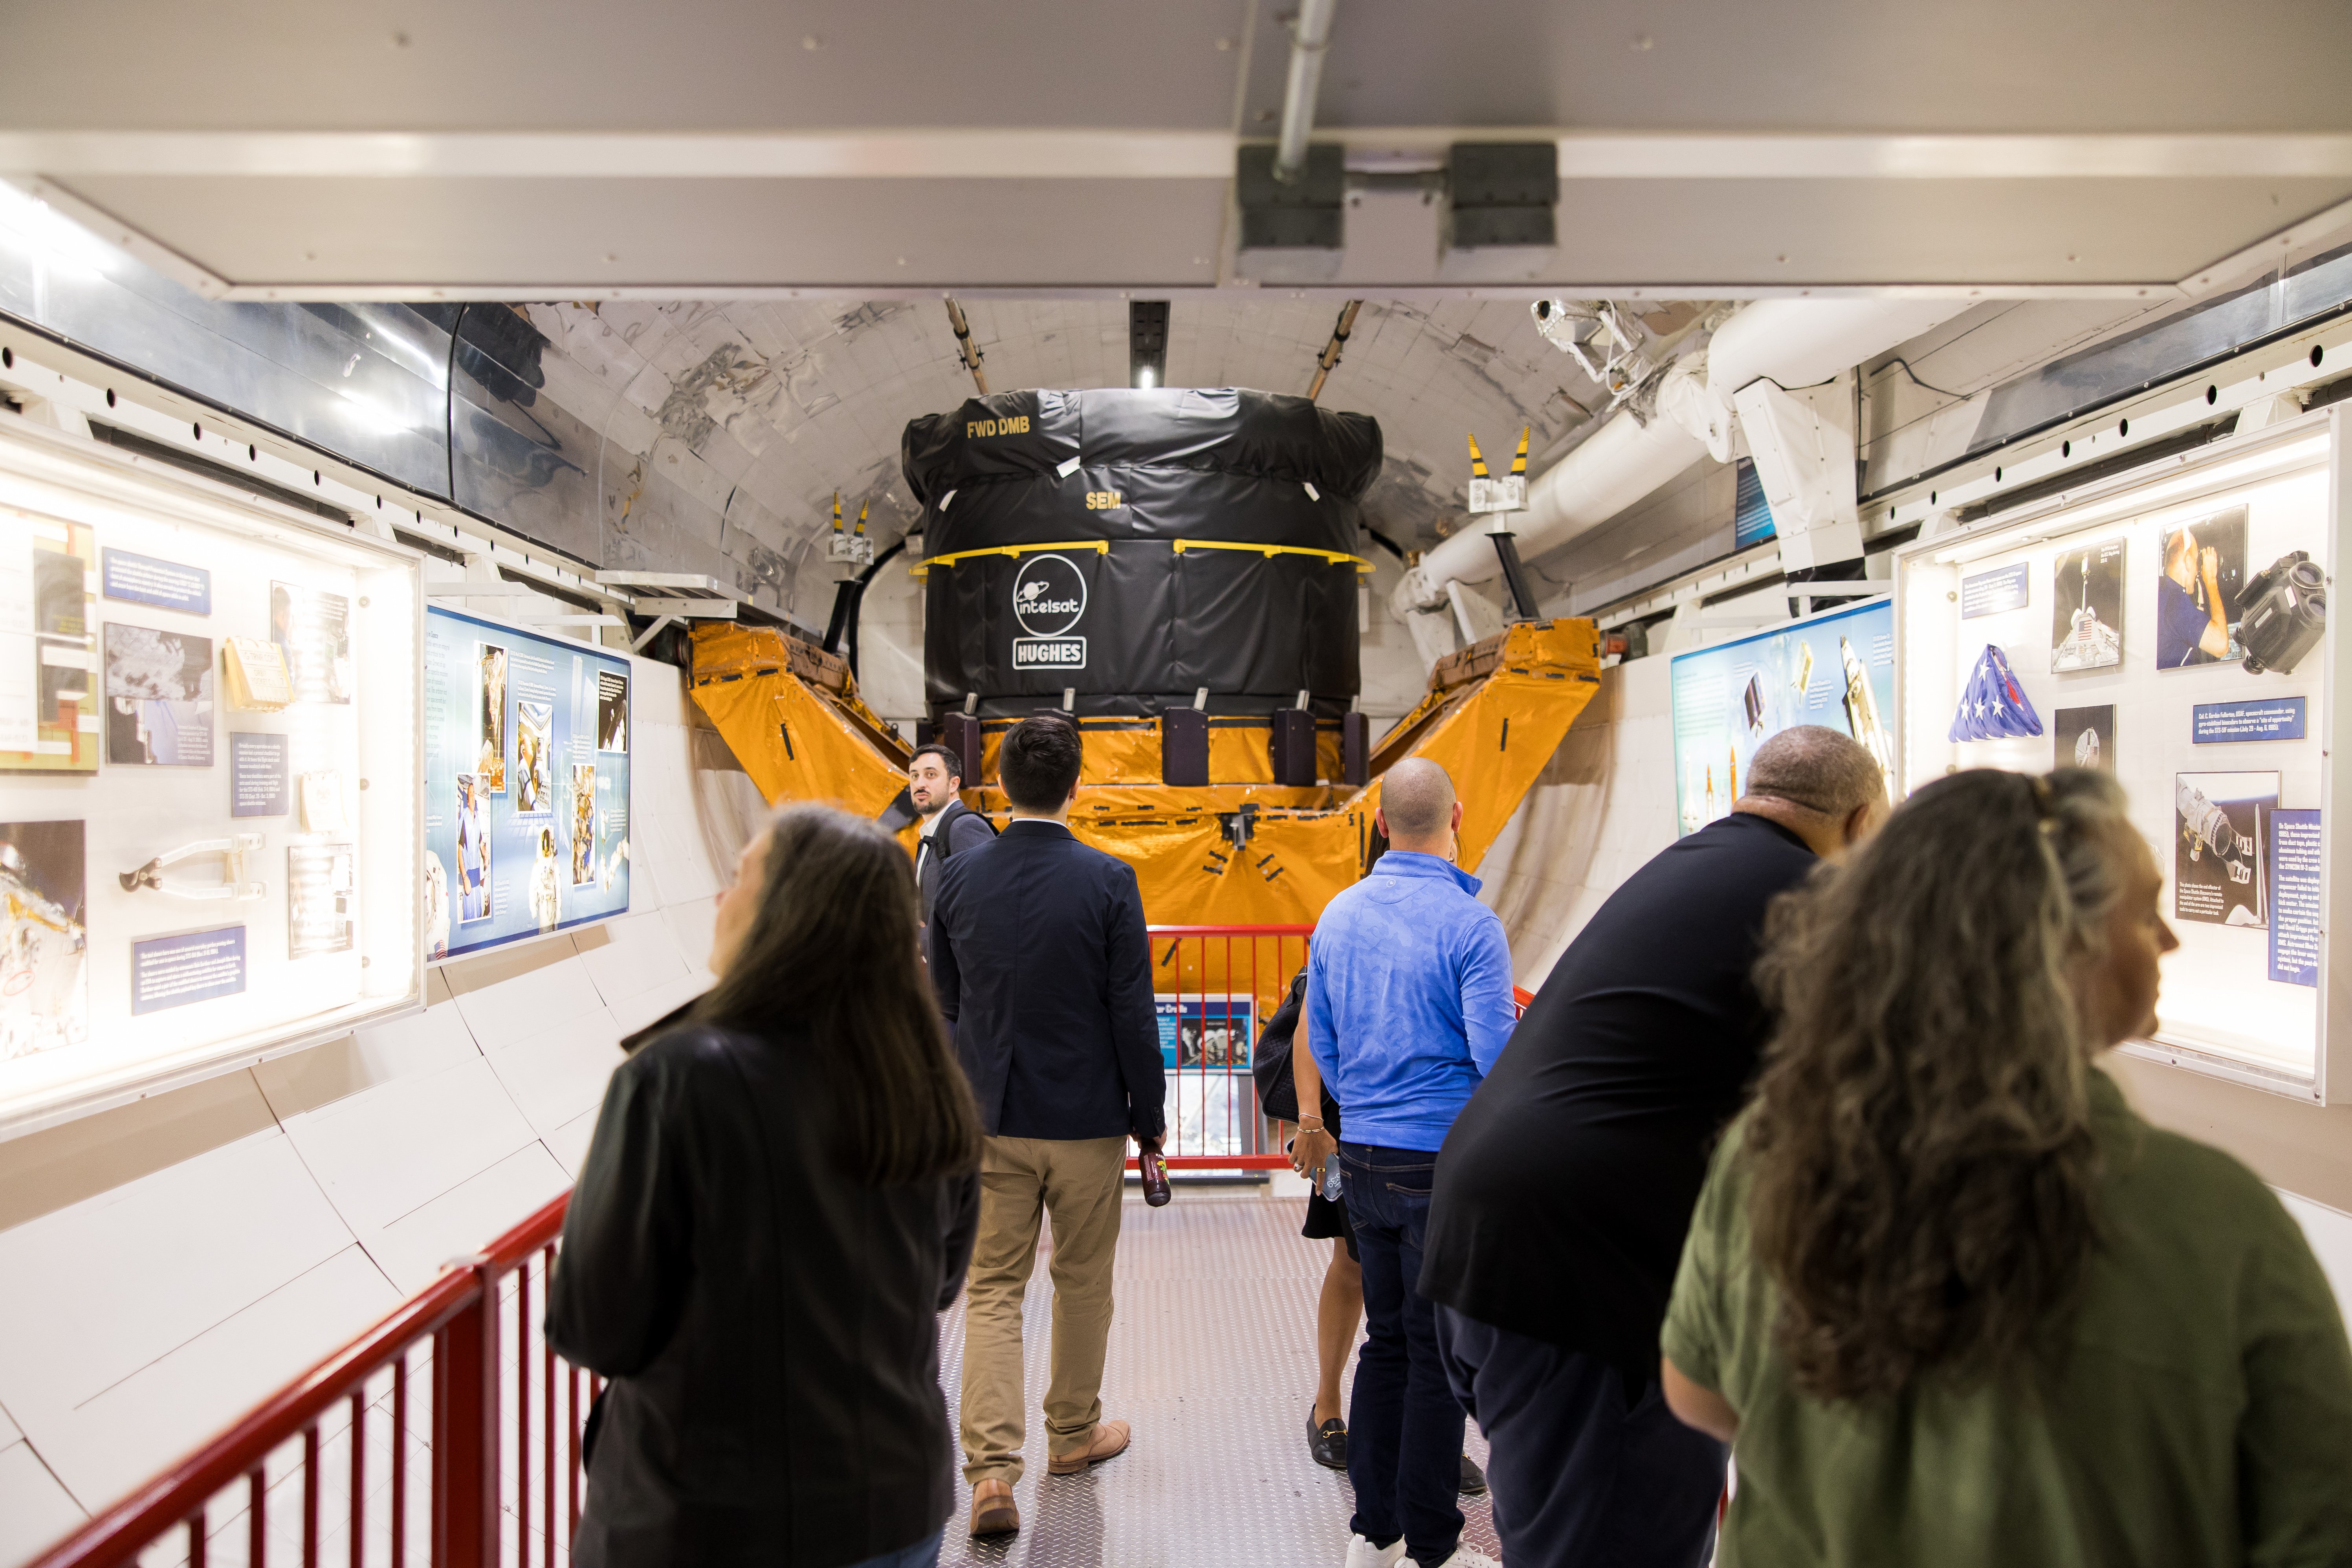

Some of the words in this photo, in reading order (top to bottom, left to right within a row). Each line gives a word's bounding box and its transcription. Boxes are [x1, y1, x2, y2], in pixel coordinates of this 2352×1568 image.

[967, 419, 996, 438] FWD
[998, 416, 1030, 435] DMB
[1086, 491, 1121, 510] SEM
[1019, 599, 1080, 614] intelsat
[1017, 644, 1081, 662] HUGHES
[1165, 1004, 1188, 1014] Crale
